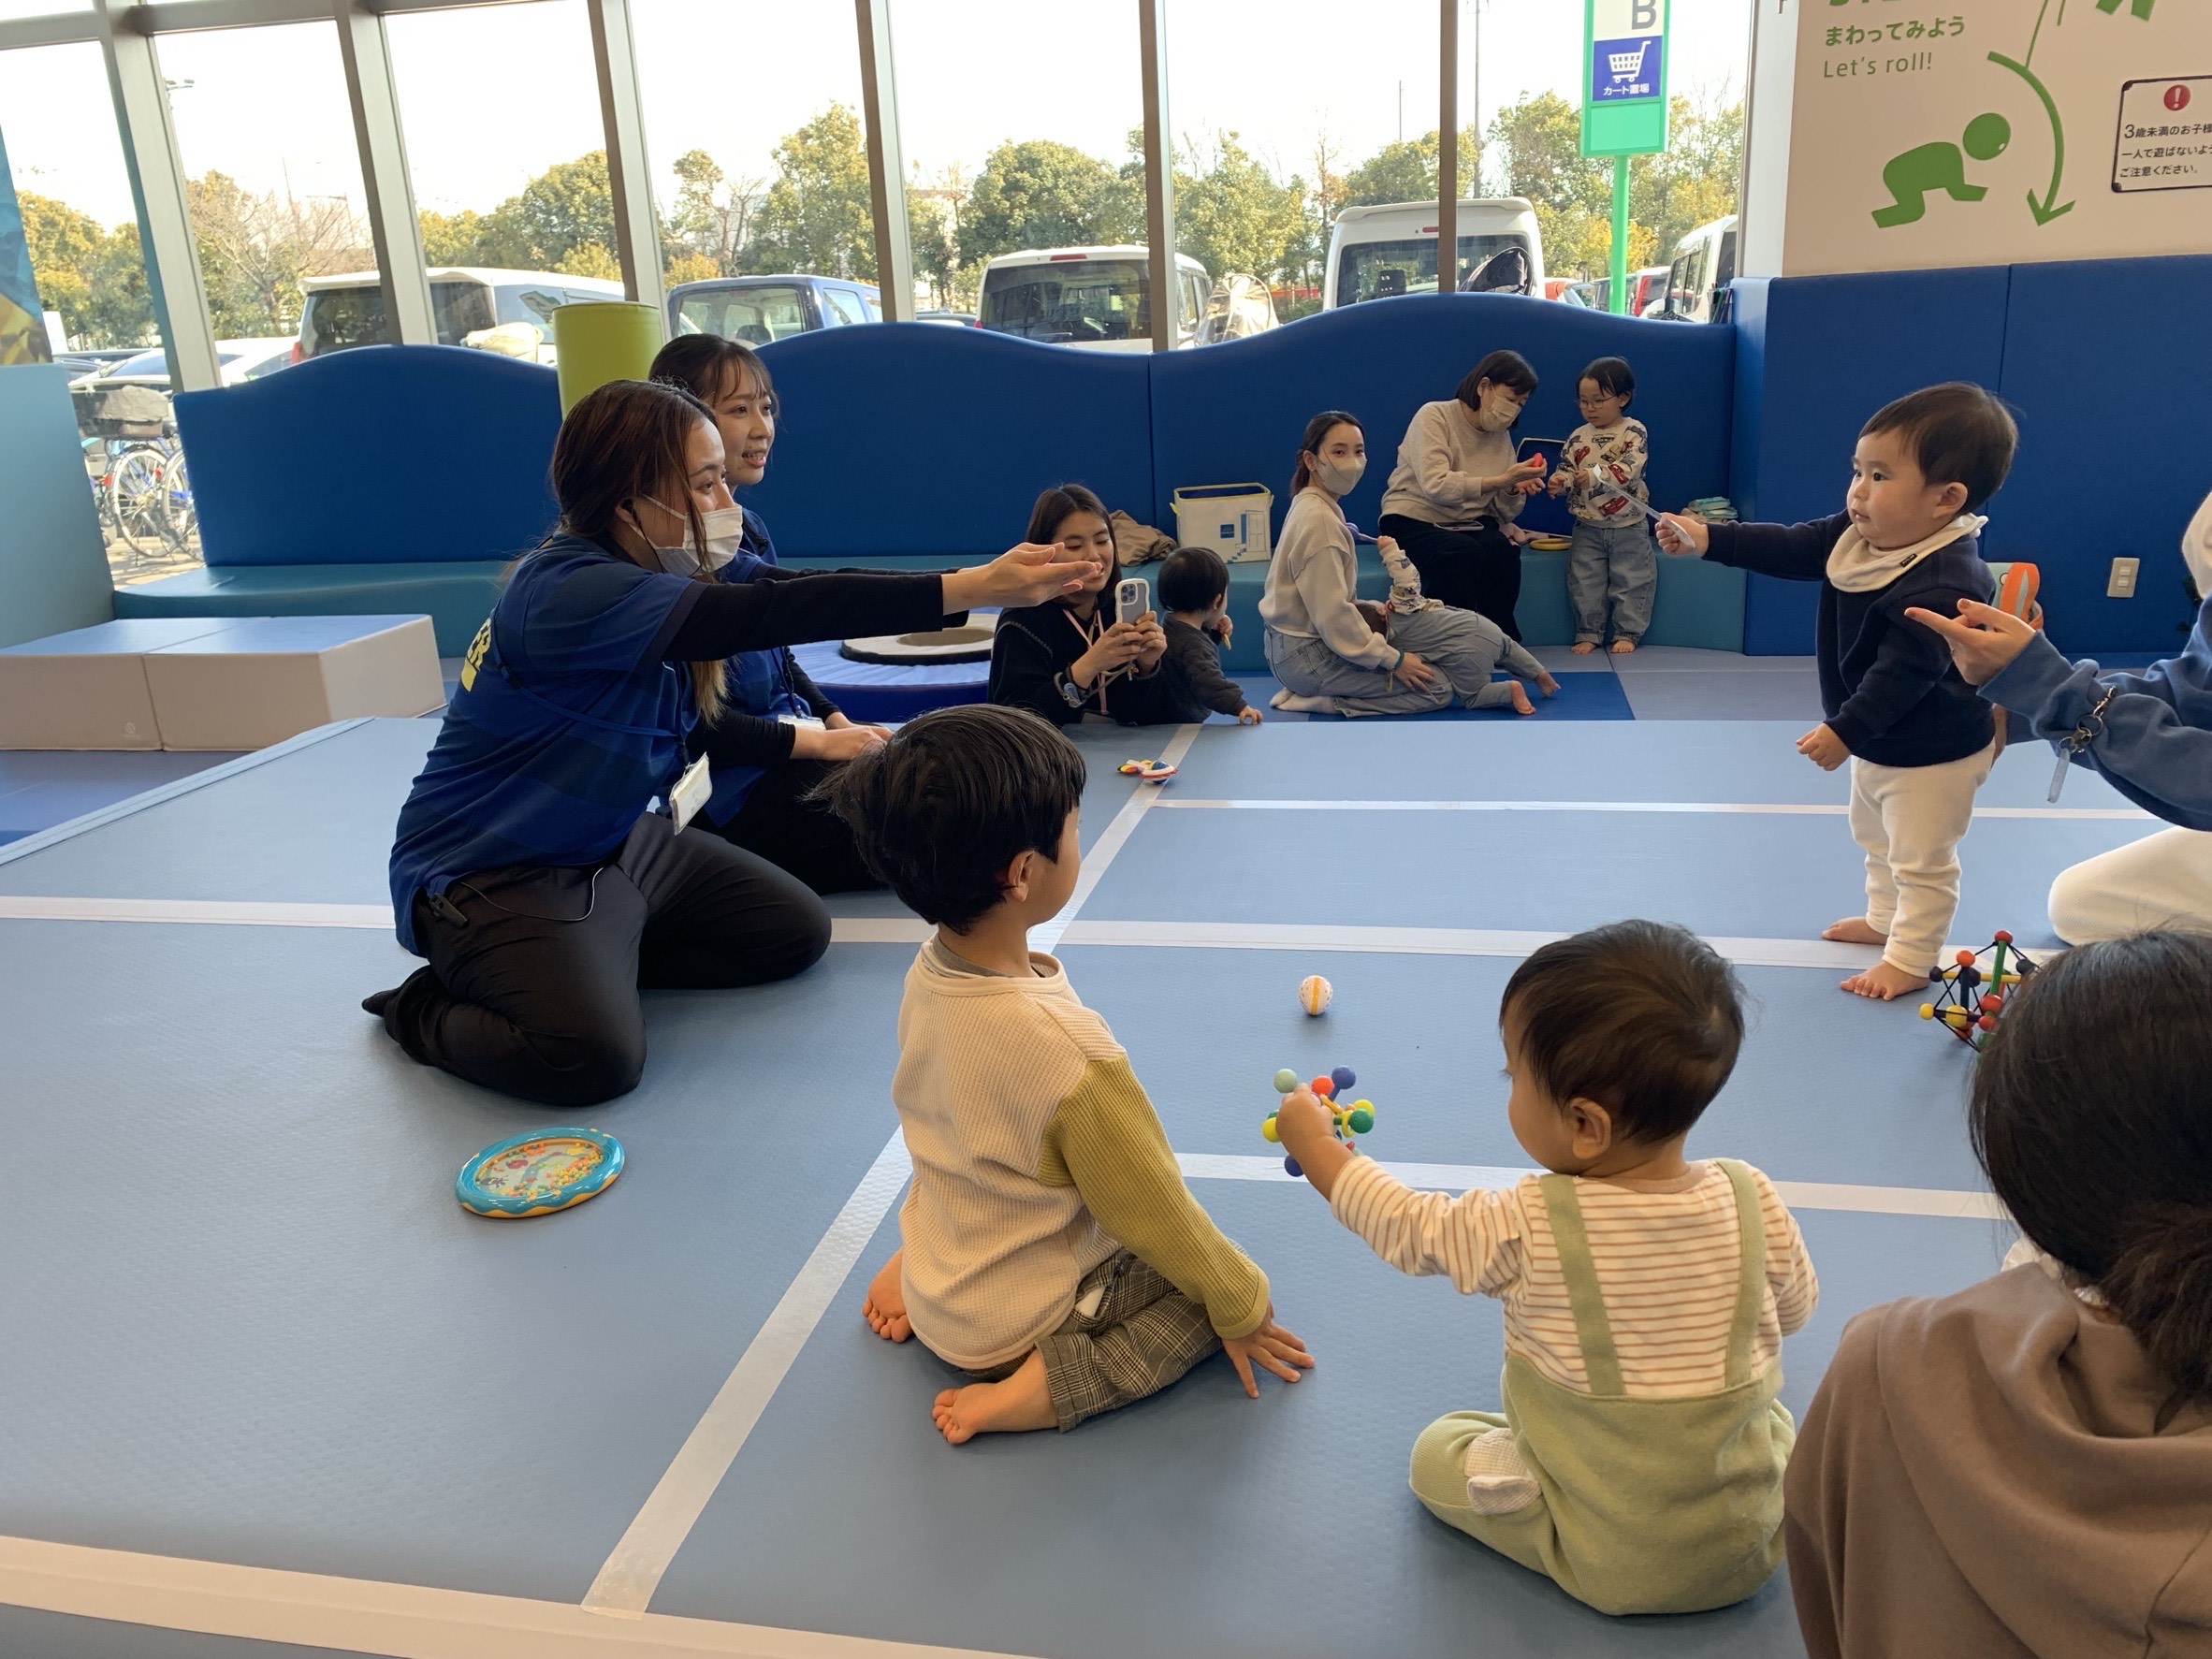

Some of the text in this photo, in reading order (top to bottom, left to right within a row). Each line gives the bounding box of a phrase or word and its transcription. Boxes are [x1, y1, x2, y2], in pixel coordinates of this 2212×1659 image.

[1632, 0, 1657, 30] B
[1826, 16, 1965, 46] まわってみよう
[1885, 51, 1933, 73] roll!
[2124, 124, 2212, 138] 3歳未満のお子様
